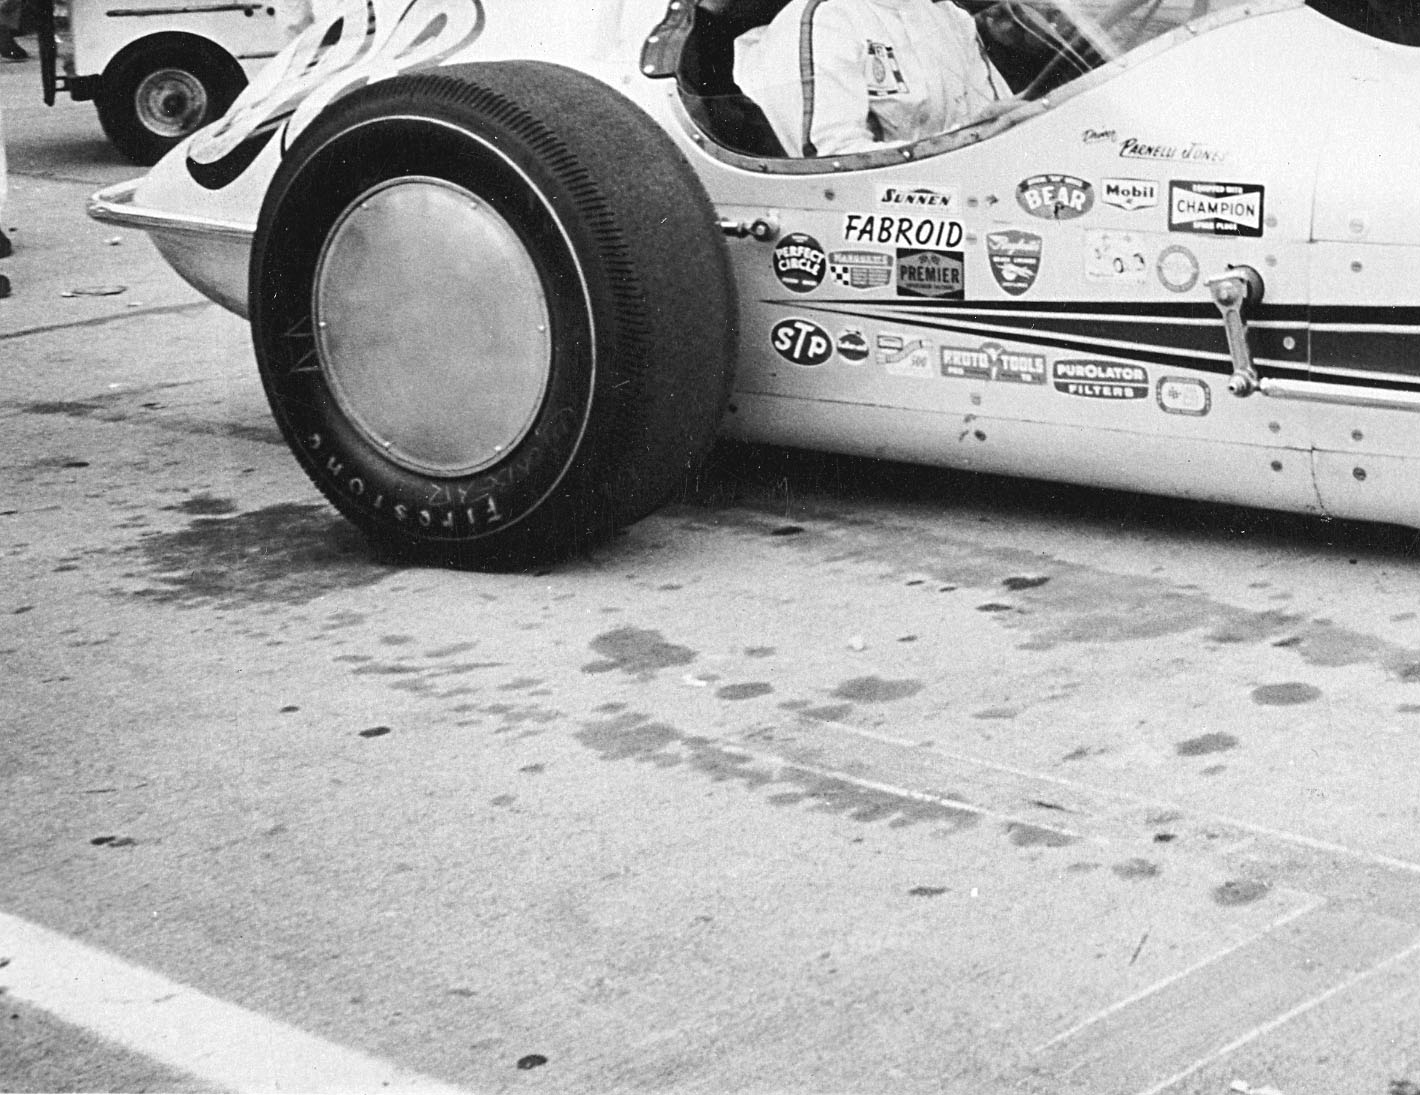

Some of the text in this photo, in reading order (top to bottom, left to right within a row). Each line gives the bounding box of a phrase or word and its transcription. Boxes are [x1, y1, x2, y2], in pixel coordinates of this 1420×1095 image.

[881, 189, 950, 206] SUNNEN
[1024, 186, 1086, 211] BEAR
[1106, 185, 1154, 198] Mobil
[1177, 199, 1255, 216] CHAMPION
[845, 214, 963, 247] FABROID
[775, 245, 825, 263] PERFECT
[778, 257, 821, 276] CIRCLE
[900, 264, 960, 283] PREMIER
[774, 321, 828, 359] STP
[1001, 355, 1044, 373] TOOLS
[1057, 363, 1144, 381] PUROLATOR
[1068, 384, 1134, 398] FILTERS
